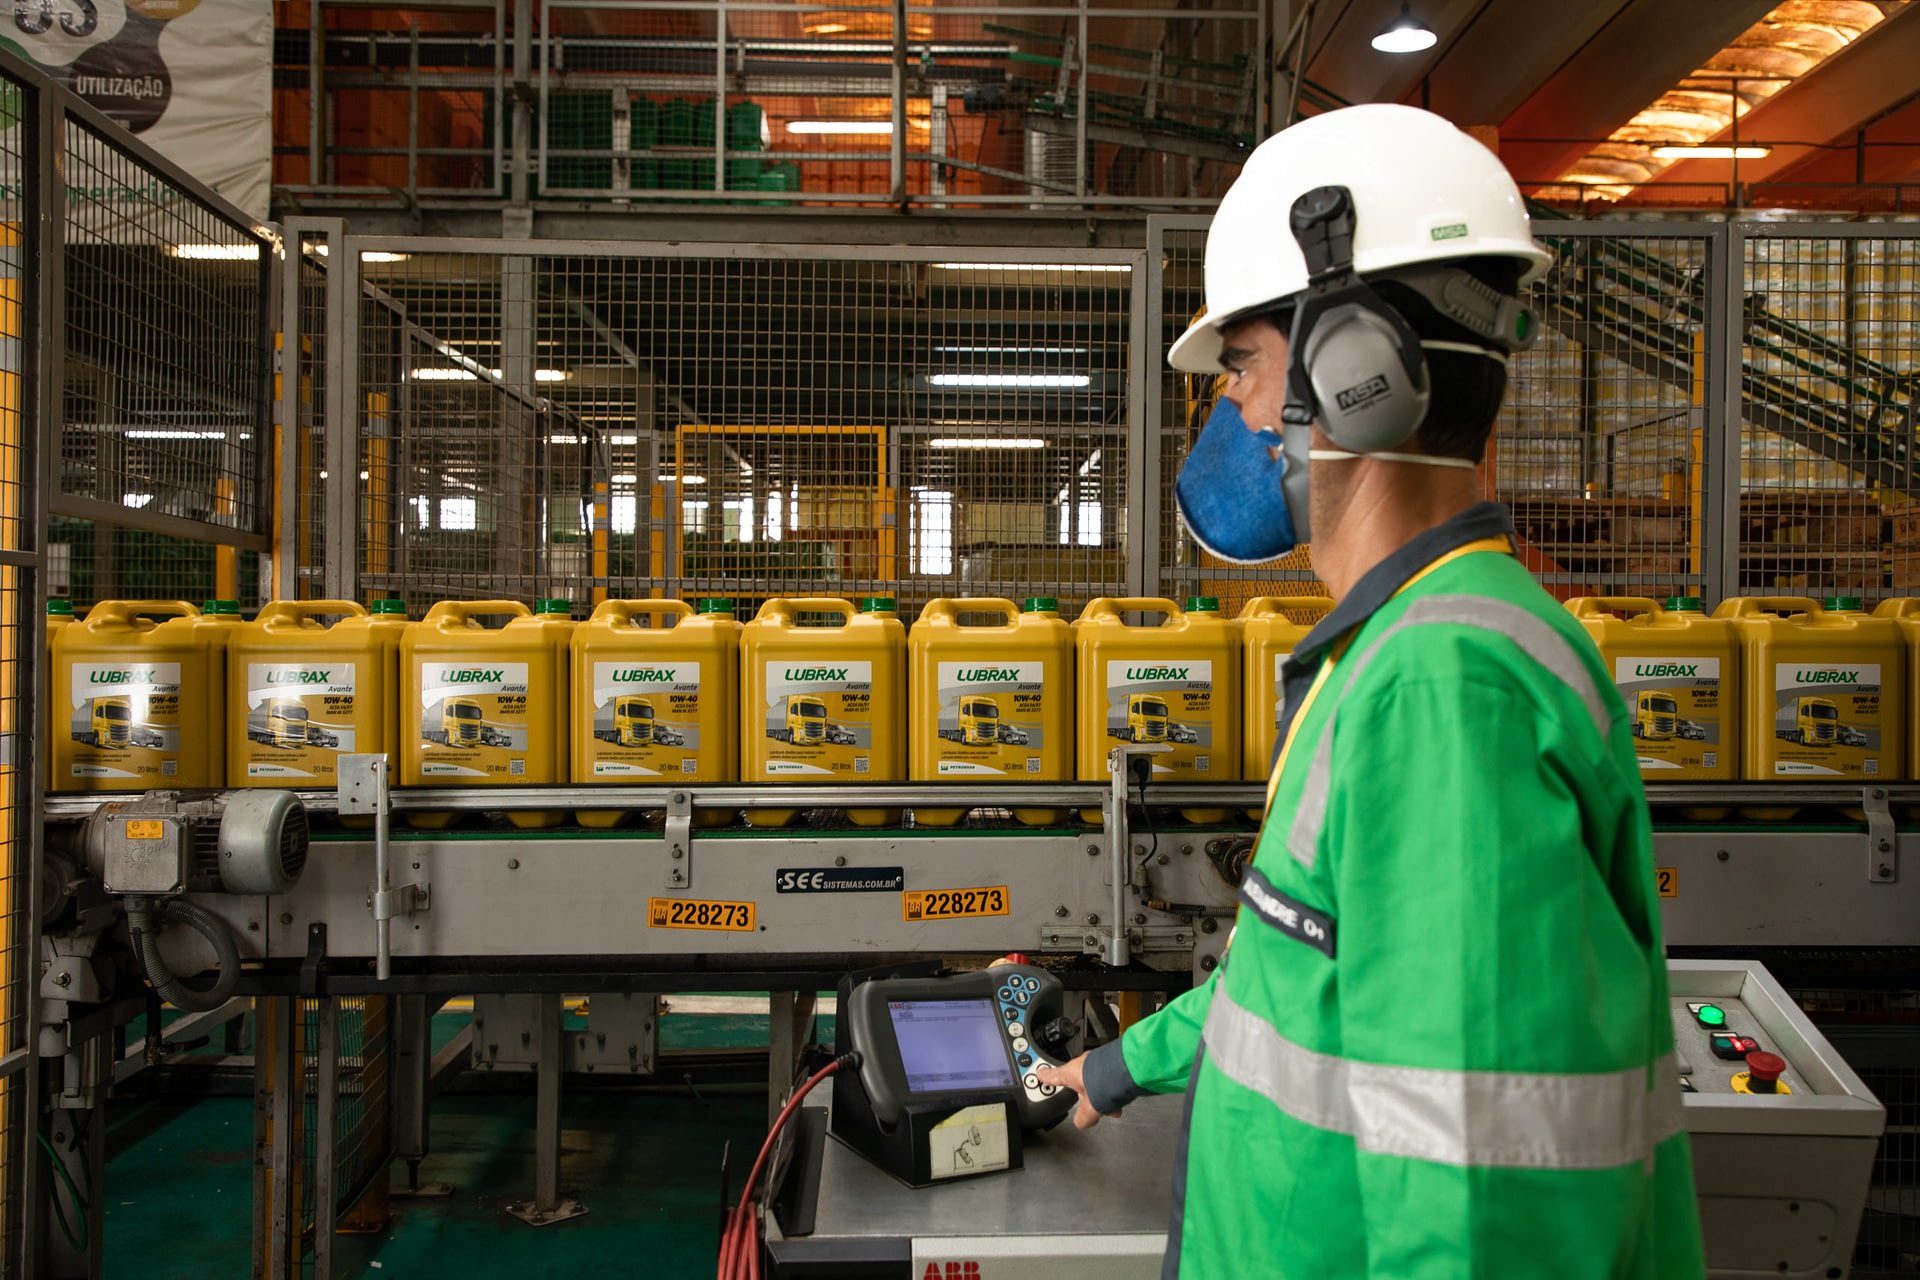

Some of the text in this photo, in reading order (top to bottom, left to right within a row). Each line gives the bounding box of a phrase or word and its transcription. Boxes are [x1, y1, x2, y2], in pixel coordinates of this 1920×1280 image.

[76, 75, 163, 100] UTILIZAÇÃO
[1338, 377, 1388, 408] MSA
[440, 670, 504, 683] LUBRAX
[612, 669, 676, 682] LUBRAX
[784, 668, 848, 681] LUBRAX
[956, 669, 1021, 682] LUBRAX
[1126, 668, 1190, 680] LUBRAX
[1635, 664, 1698, 677] LUBRAX
[90, 670, 156, 684] LUBRAX
[266, 671, 331, 684] LUBRAX
[1795, 671, 1860, 683] LUBRAX
[323, 696, 353, 704] 10W-40
[497, 696, 526, 704] 10W-40
[669, 695, 698, 703] 10W-40
[841, 694, 870, 702] 10W-40
[1013, 694, 1042, 702] 10W-40
[1183, 693, 1210, 701] 10W-40
[1691, 690, 1718, 698] 10W-40
[831, 762, 852, 770] 20 litros
[1172, 761, 1192, 769] 20 litros
[1680, 757, 1689, 765] 20
[1842, 763, 1849, 771] 20
[312, 765, 321, 773] 20
[486, 764, 507, 772] 20 litros
[659, 764, 679, 772] 20 litros
[782, 872, 896, 890] SEE SISTEMAS.COM.BR
[1658, 871, 1671, 893] 2
[925, 889, 1003, 916] 228273
[671, 902, 749, 927] 228273
[922, 1260, 981, 1280] ABB
